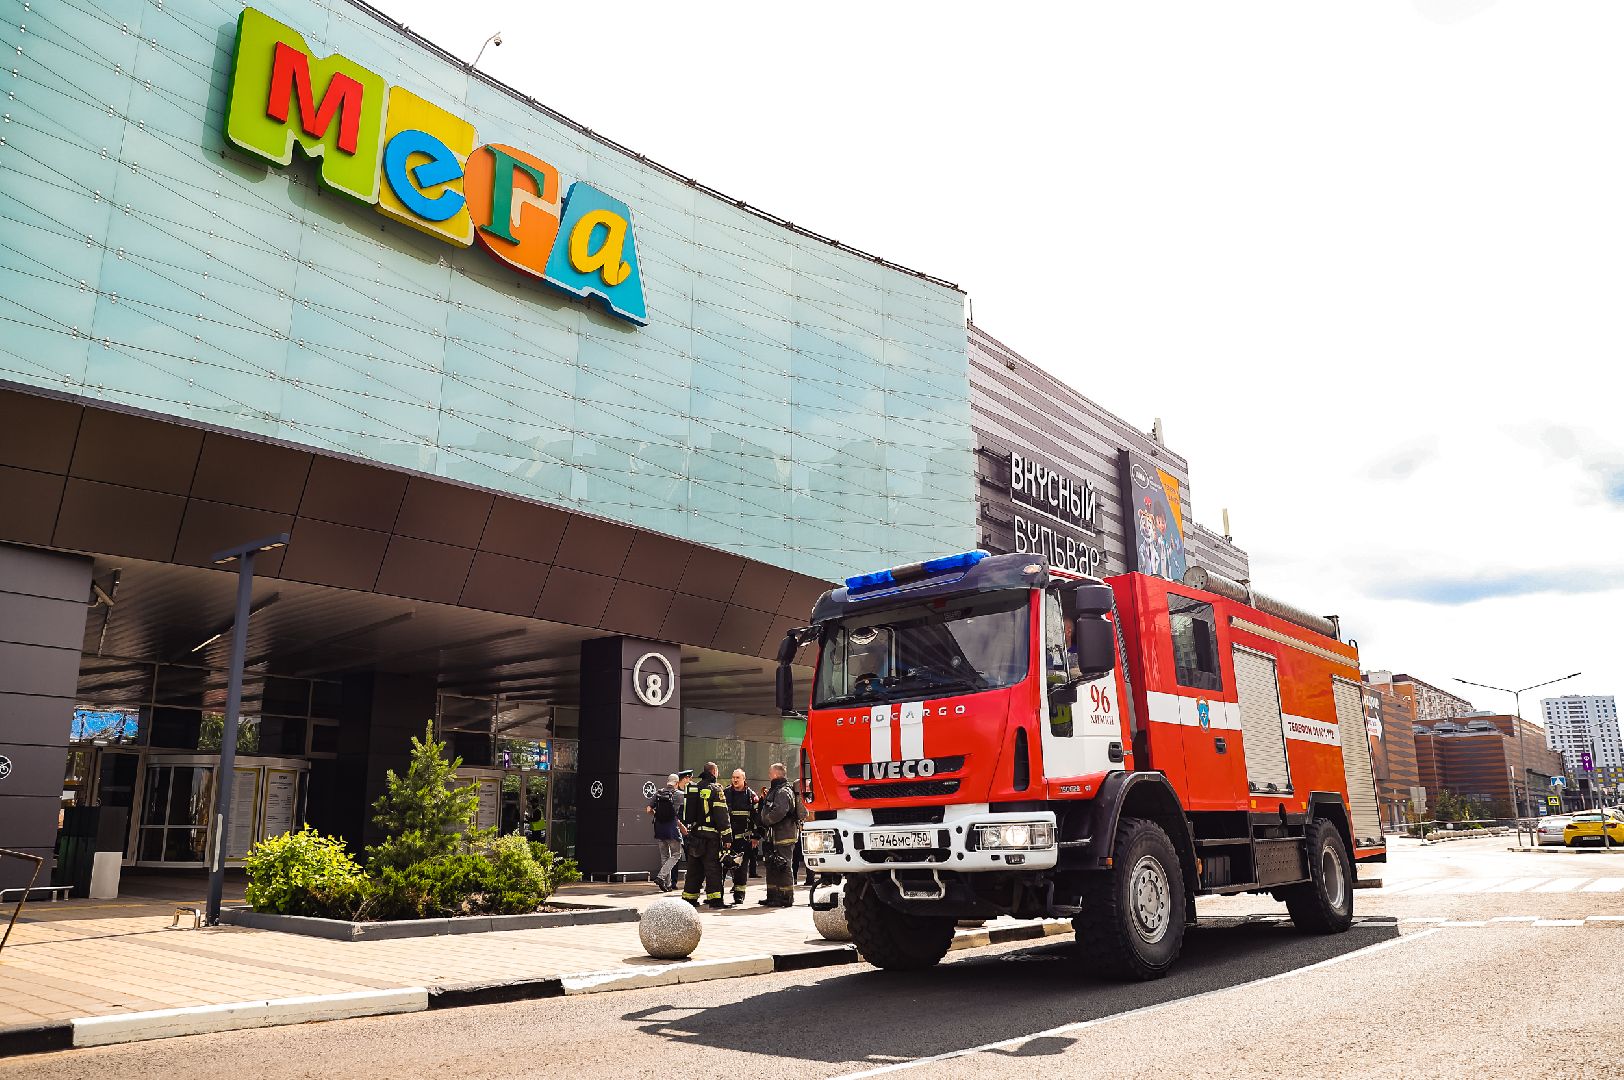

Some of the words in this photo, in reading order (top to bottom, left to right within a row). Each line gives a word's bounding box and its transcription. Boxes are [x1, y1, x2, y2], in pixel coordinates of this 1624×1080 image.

[1011, 452, 1096, 524] ВКУСНЫЙ
[645, 674, 662, 706] 8
[1090, 684, 1111, 713] 96
[836, 705, 966, 726] EUROCARGO
[862, 759, 935, 780] IVECO
